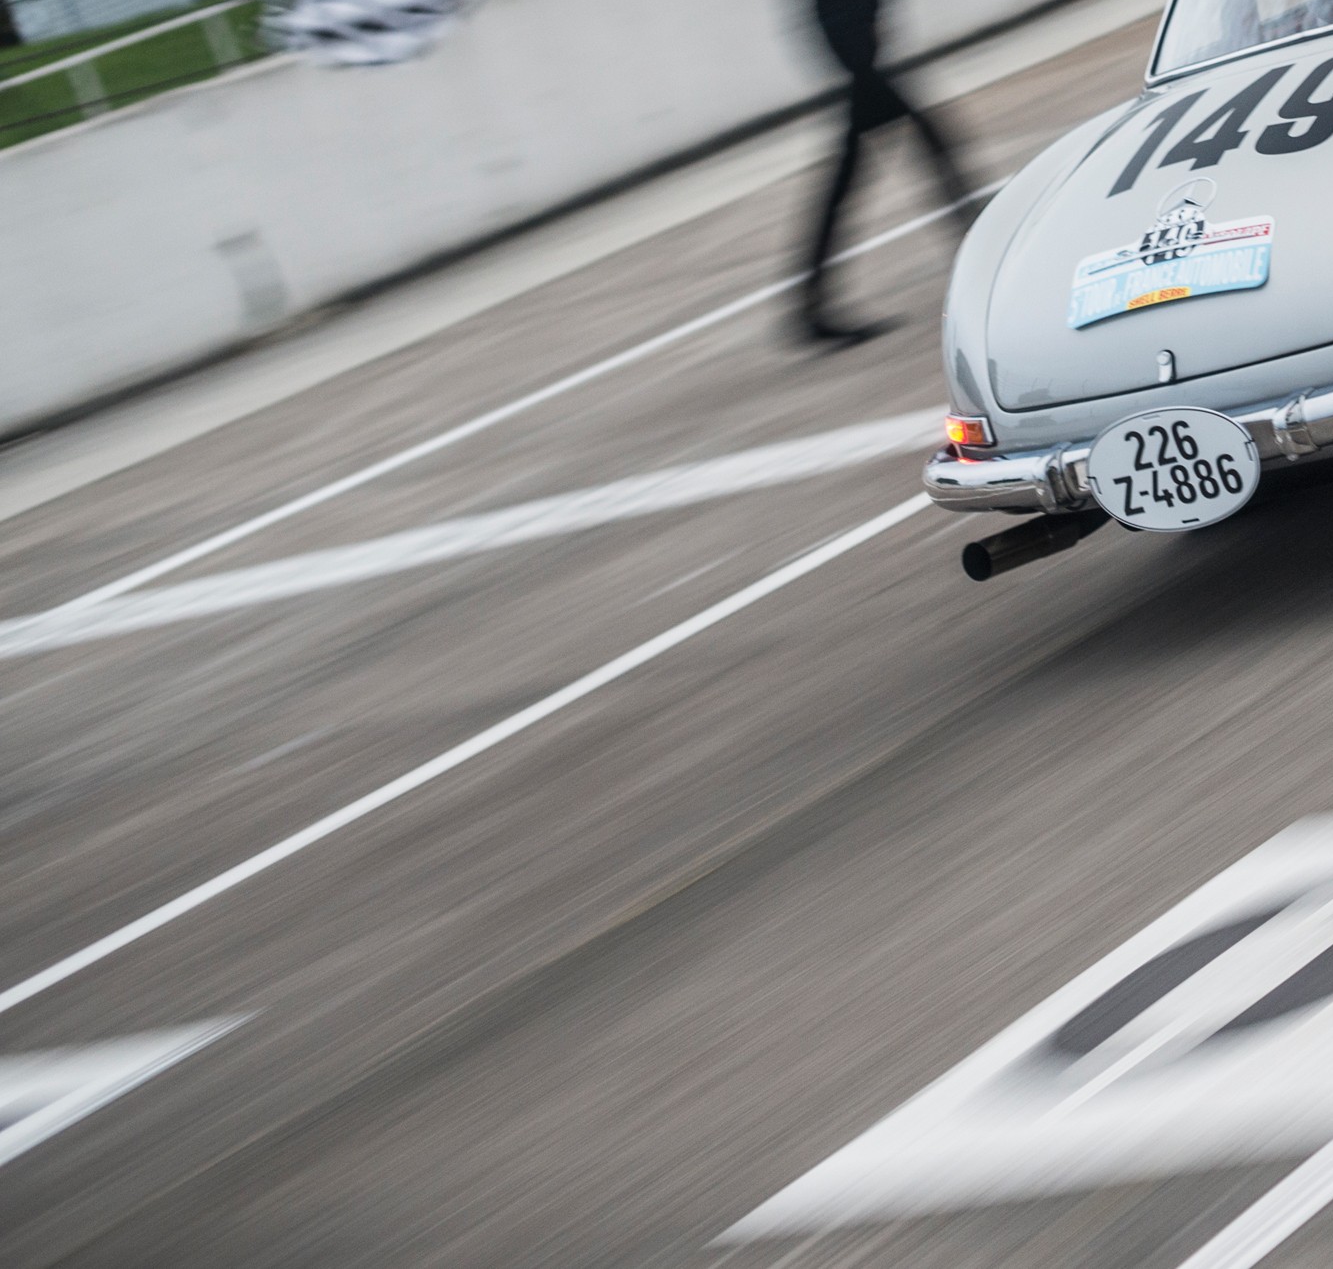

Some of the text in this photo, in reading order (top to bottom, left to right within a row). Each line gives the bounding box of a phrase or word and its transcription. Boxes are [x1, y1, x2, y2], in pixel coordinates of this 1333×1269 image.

[1122, 263, 1178, 301] FRANCE
[1172, 246, 1267, 285] AUTOMOBILE
[1124, 420, 1199, 472] 226
[1113, 453, 1244, 516] Z-4886
